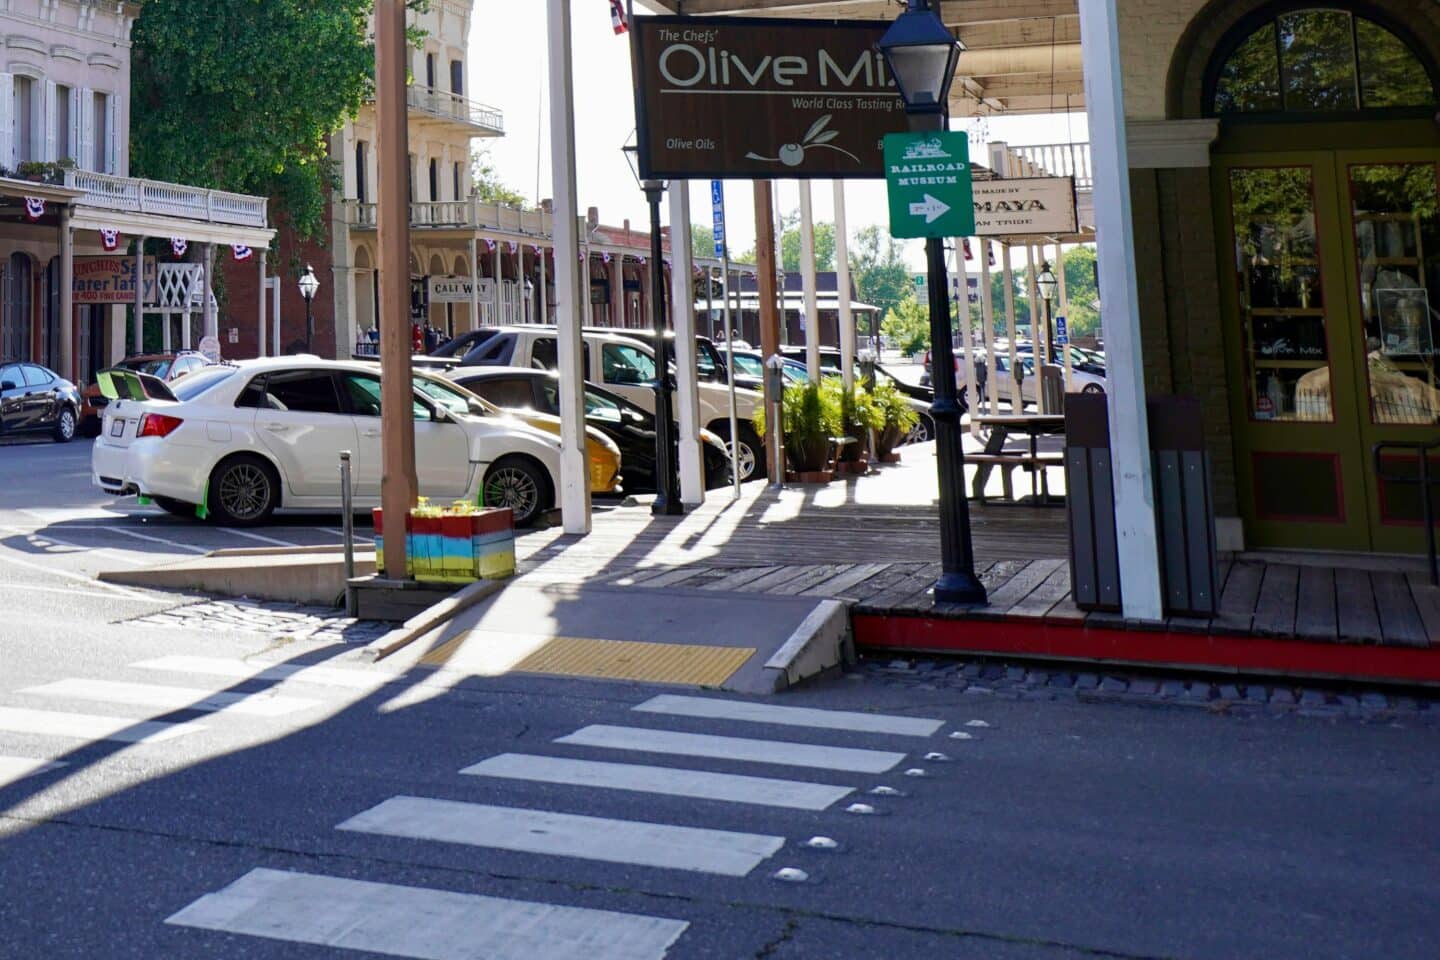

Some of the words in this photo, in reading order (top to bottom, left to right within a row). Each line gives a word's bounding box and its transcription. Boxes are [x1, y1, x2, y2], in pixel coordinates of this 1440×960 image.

[660, 30, 680, 41] The
[682, 30, 718, 43] Chefs'
[658, 43, 808, 87] Olive
[818, 48, 896, 87] Mi
[792, 98, 824, 109] World
[826, 98, 853, 109] Class
[856, 98, 893, 112] Tasting
[666, 138, 692, 150] Olive
[695, 138, 715, 150] Oils
[890, 162, 965, 174] RAILROAD
[898, 176, 957, 186] MUSEUM
[112, 275, 154, 298] Tafy
[435, 284, 458, 294] CALI
